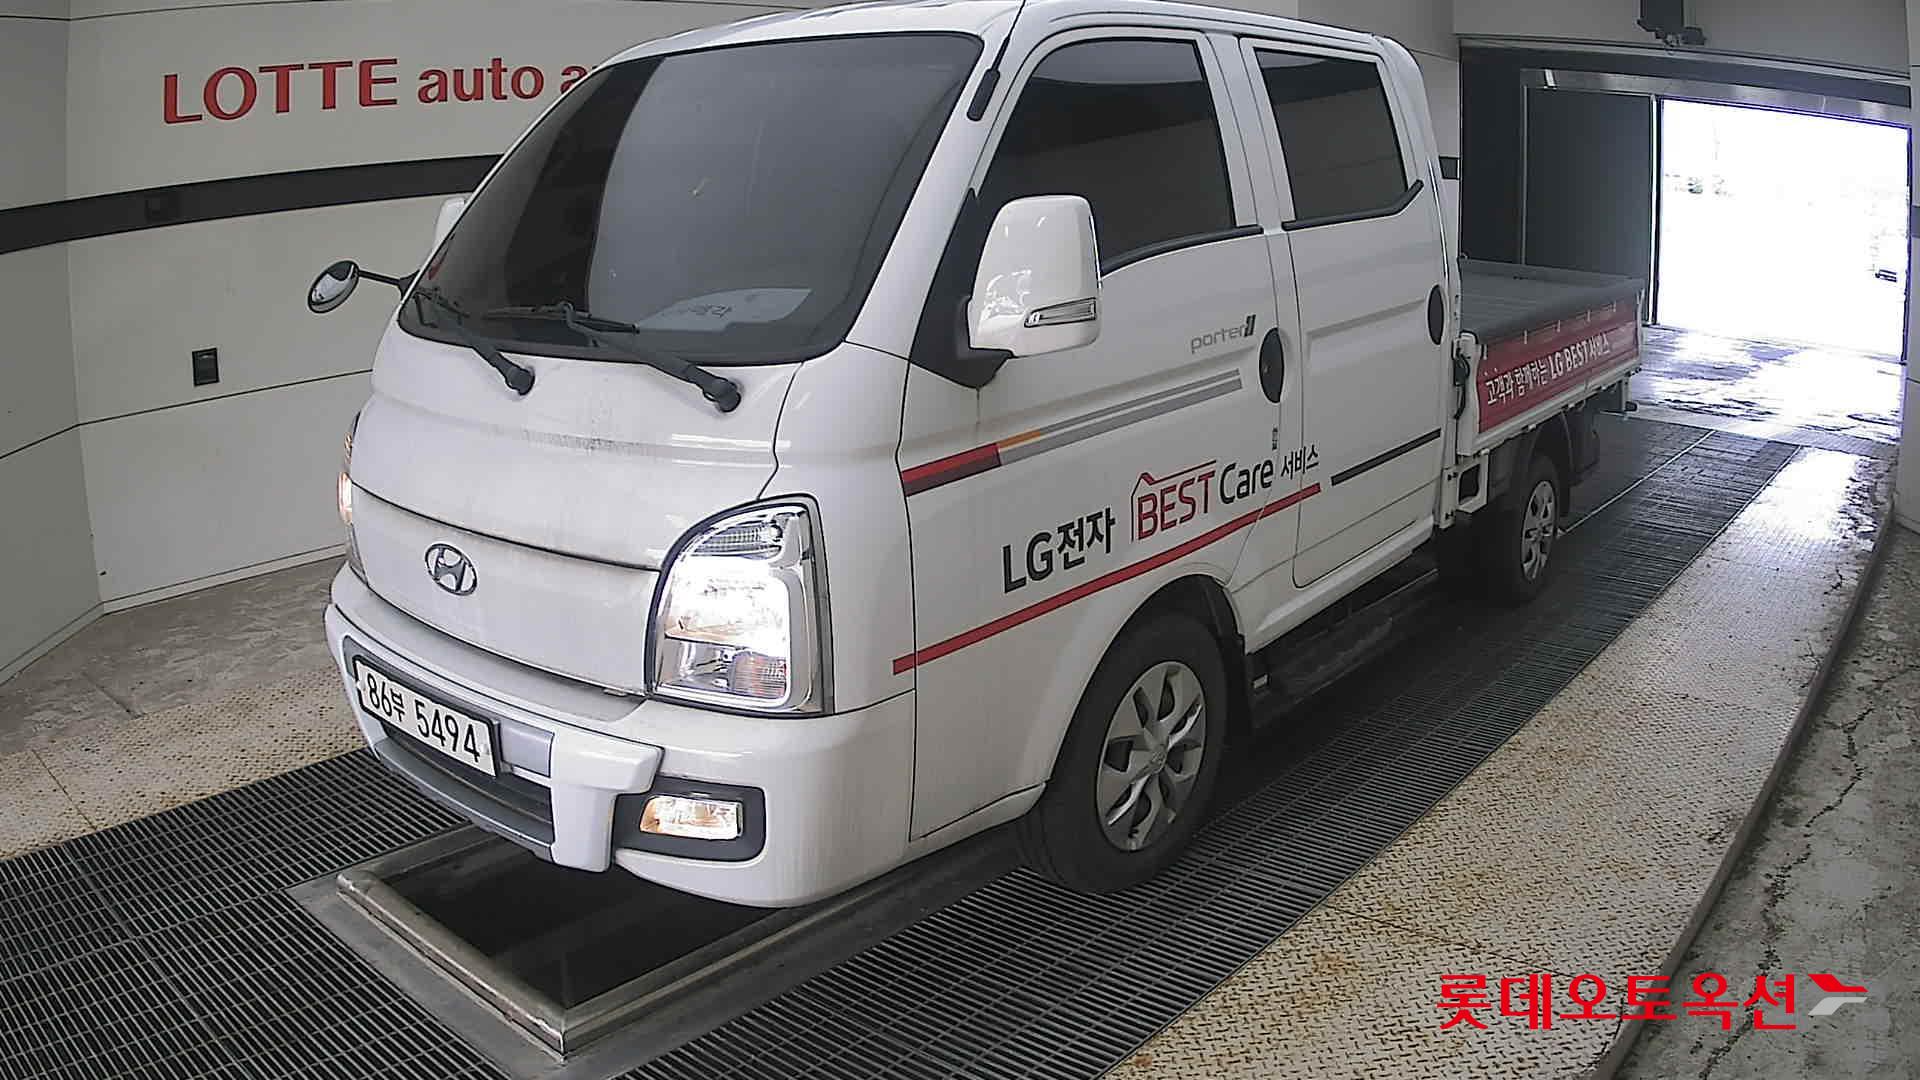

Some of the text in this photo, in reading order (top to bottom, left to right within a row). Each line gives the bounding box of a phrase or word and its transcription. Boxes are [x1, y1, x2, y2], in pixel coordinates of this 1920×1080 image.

[164, 58, 398, 124] LOTTE
[417, 57, 545, 104] auto
[1484, 371, 1514, 406] 고객과
[1513, 358, 1549, 397] 함께하는
[1548, 351, 1564, 380] LG
[1002, 444, 1320, 594] LG전자 BEST Care 서비스
[367, 672, 481, 764] 86부 5494
